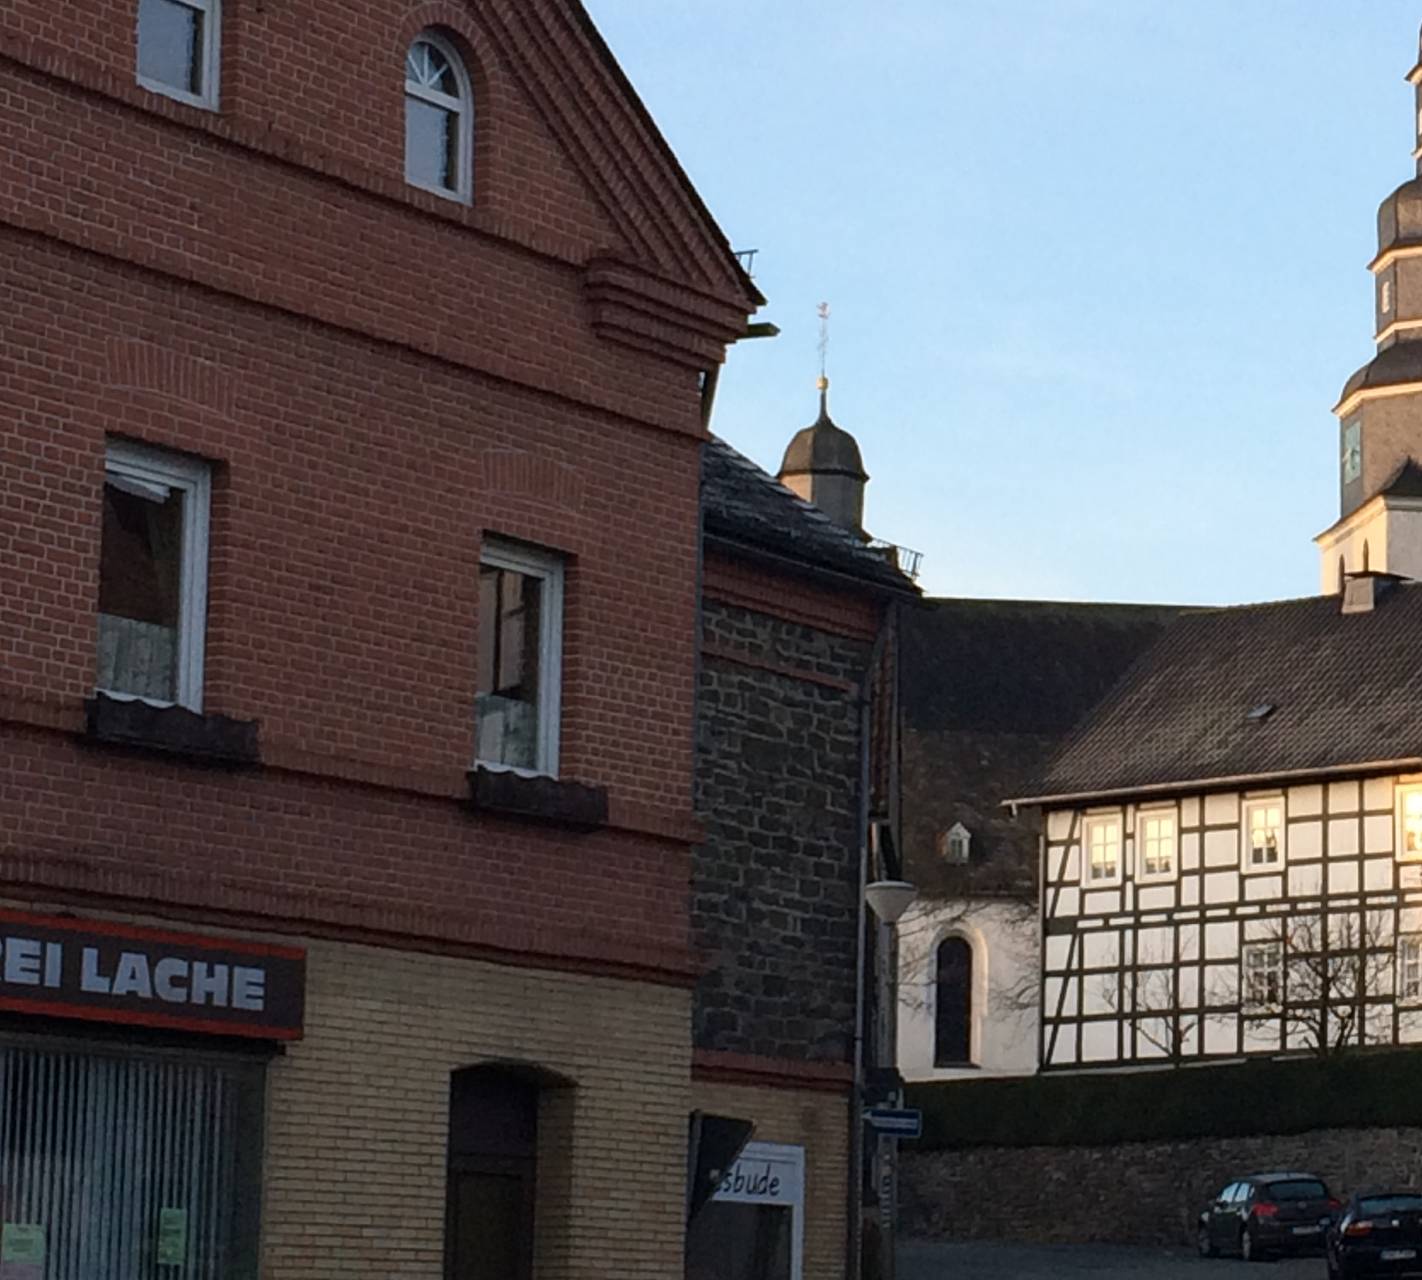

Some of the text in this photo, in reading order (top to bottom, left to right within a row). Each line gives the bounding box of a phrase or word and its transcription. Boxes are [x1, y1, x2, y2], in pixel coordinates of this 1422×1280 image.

[0, 937, 265, 1011] EI LACHE
[715, 1161, 780, 1196] sbude
